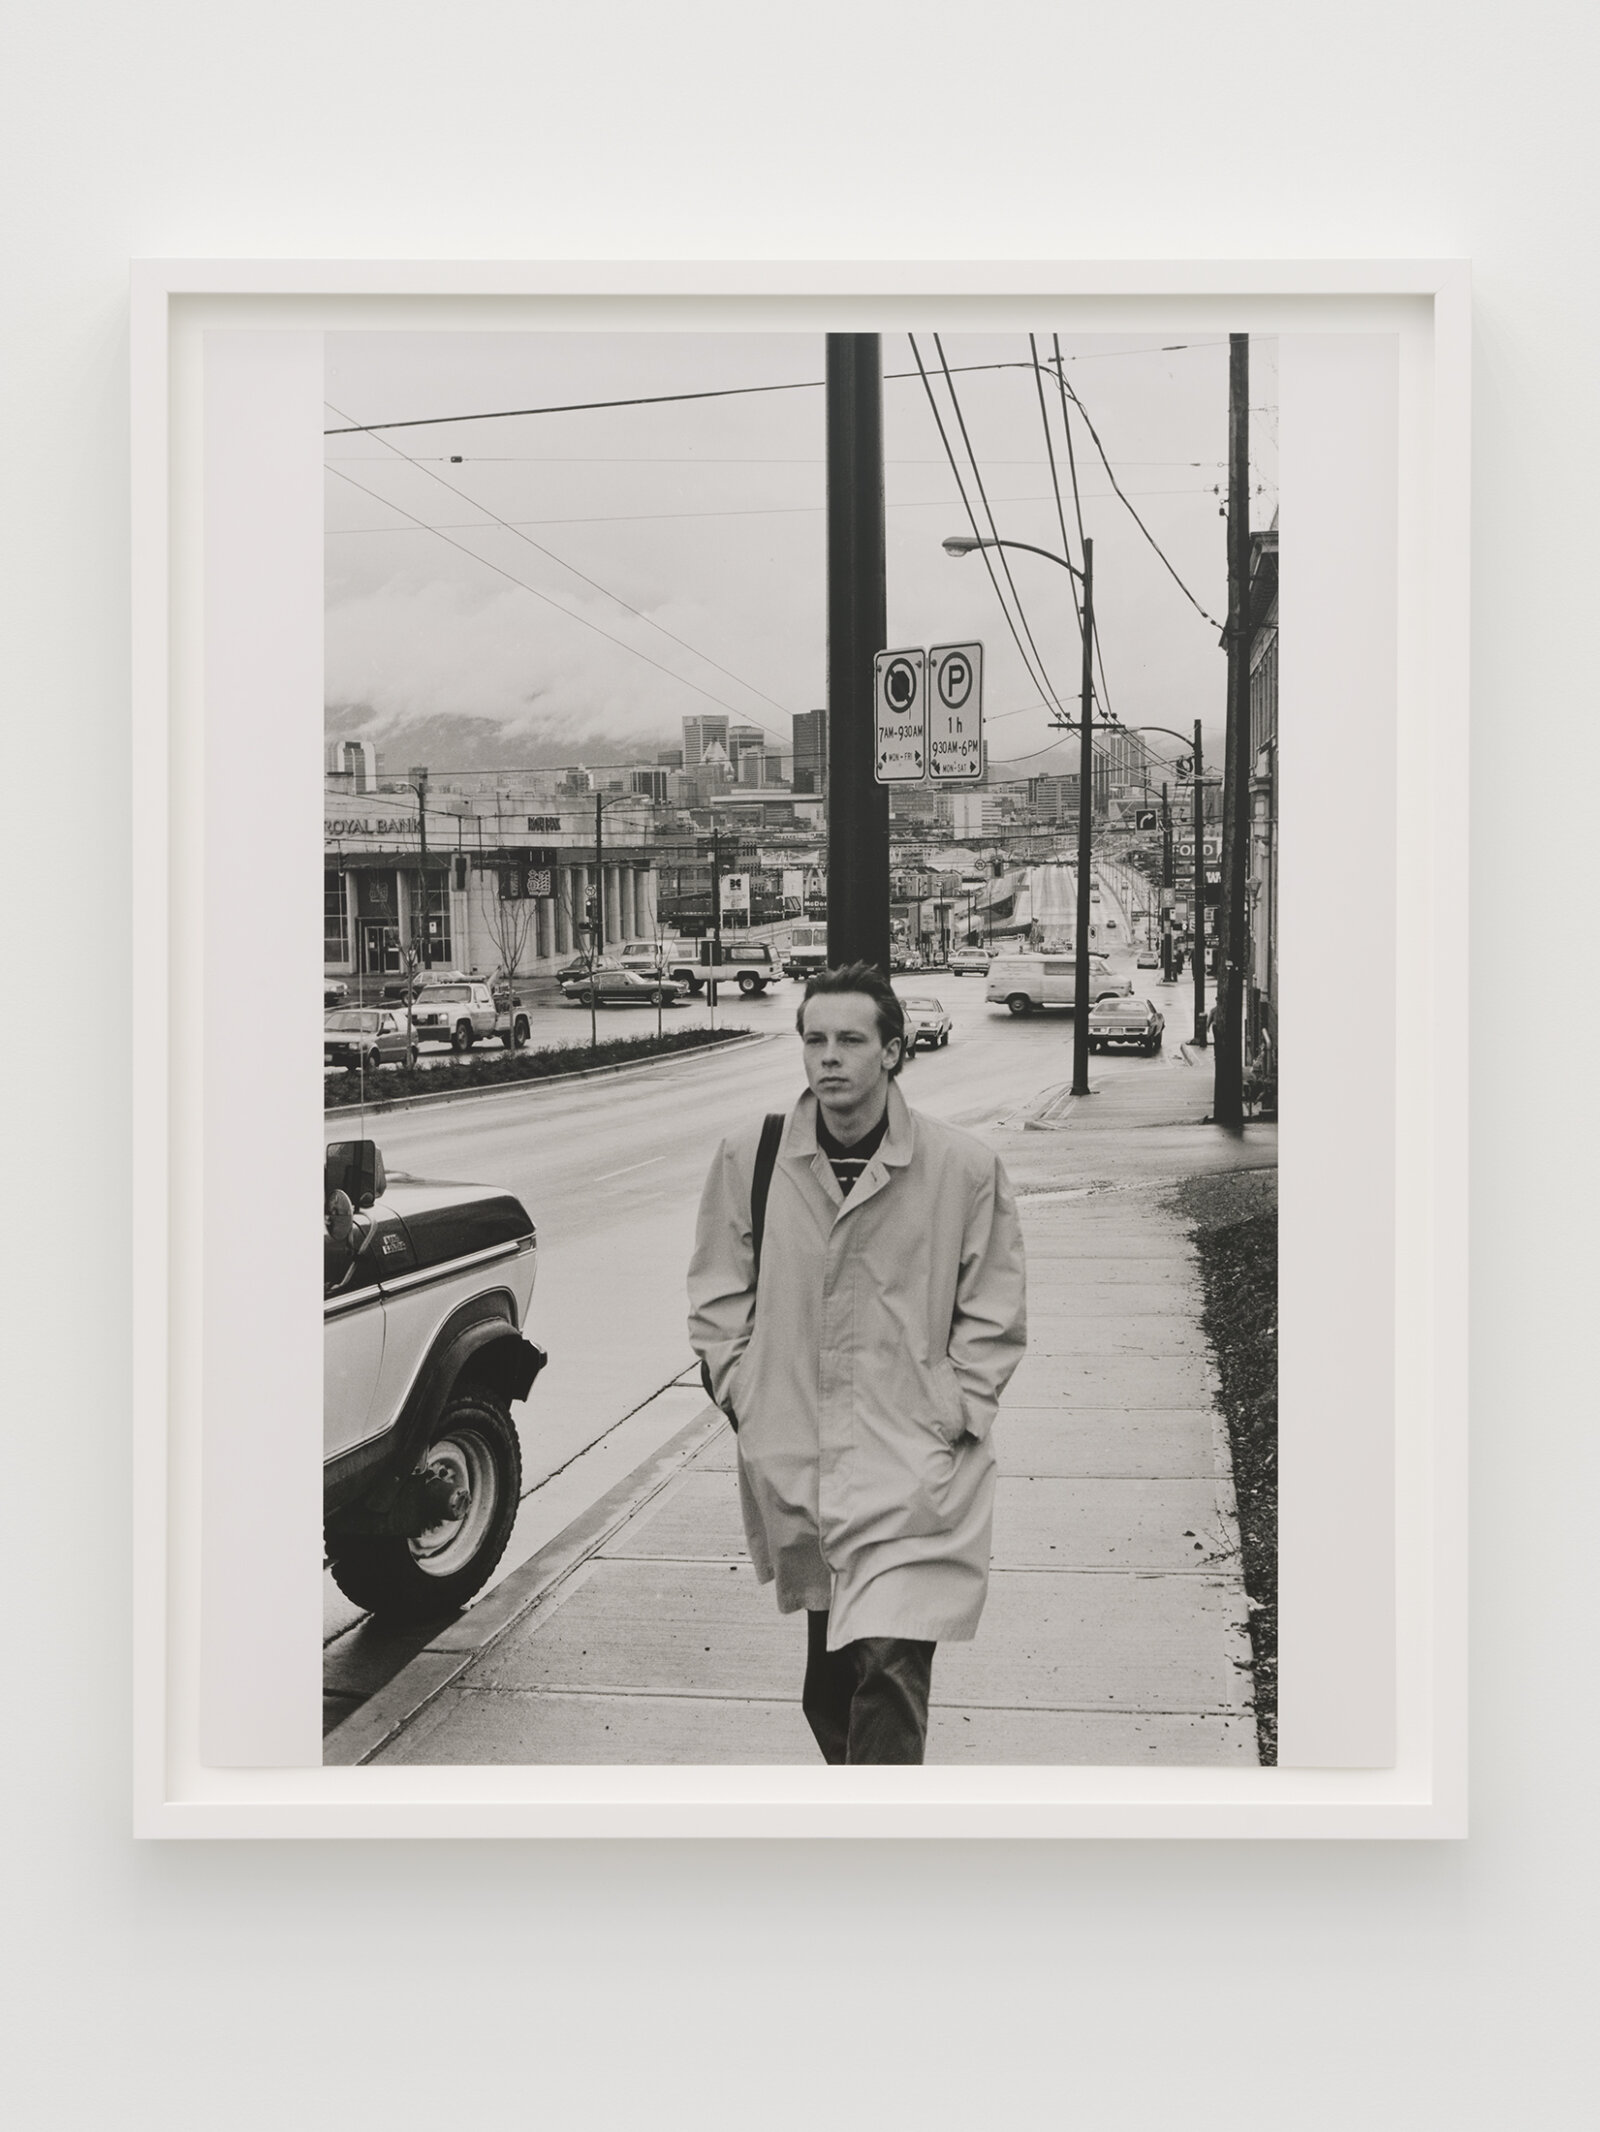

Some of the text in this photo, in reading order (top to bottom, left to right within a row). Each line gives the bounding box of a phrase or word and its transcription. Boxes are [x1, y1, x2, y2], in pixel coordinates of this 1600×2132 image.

[948, 665, 964, 697] P
[879, 726, 923, 742] 7AM-930AM
[948, 716, 963, 734] 1 h
[932, 739, 978, 757] 930AM-6PM
